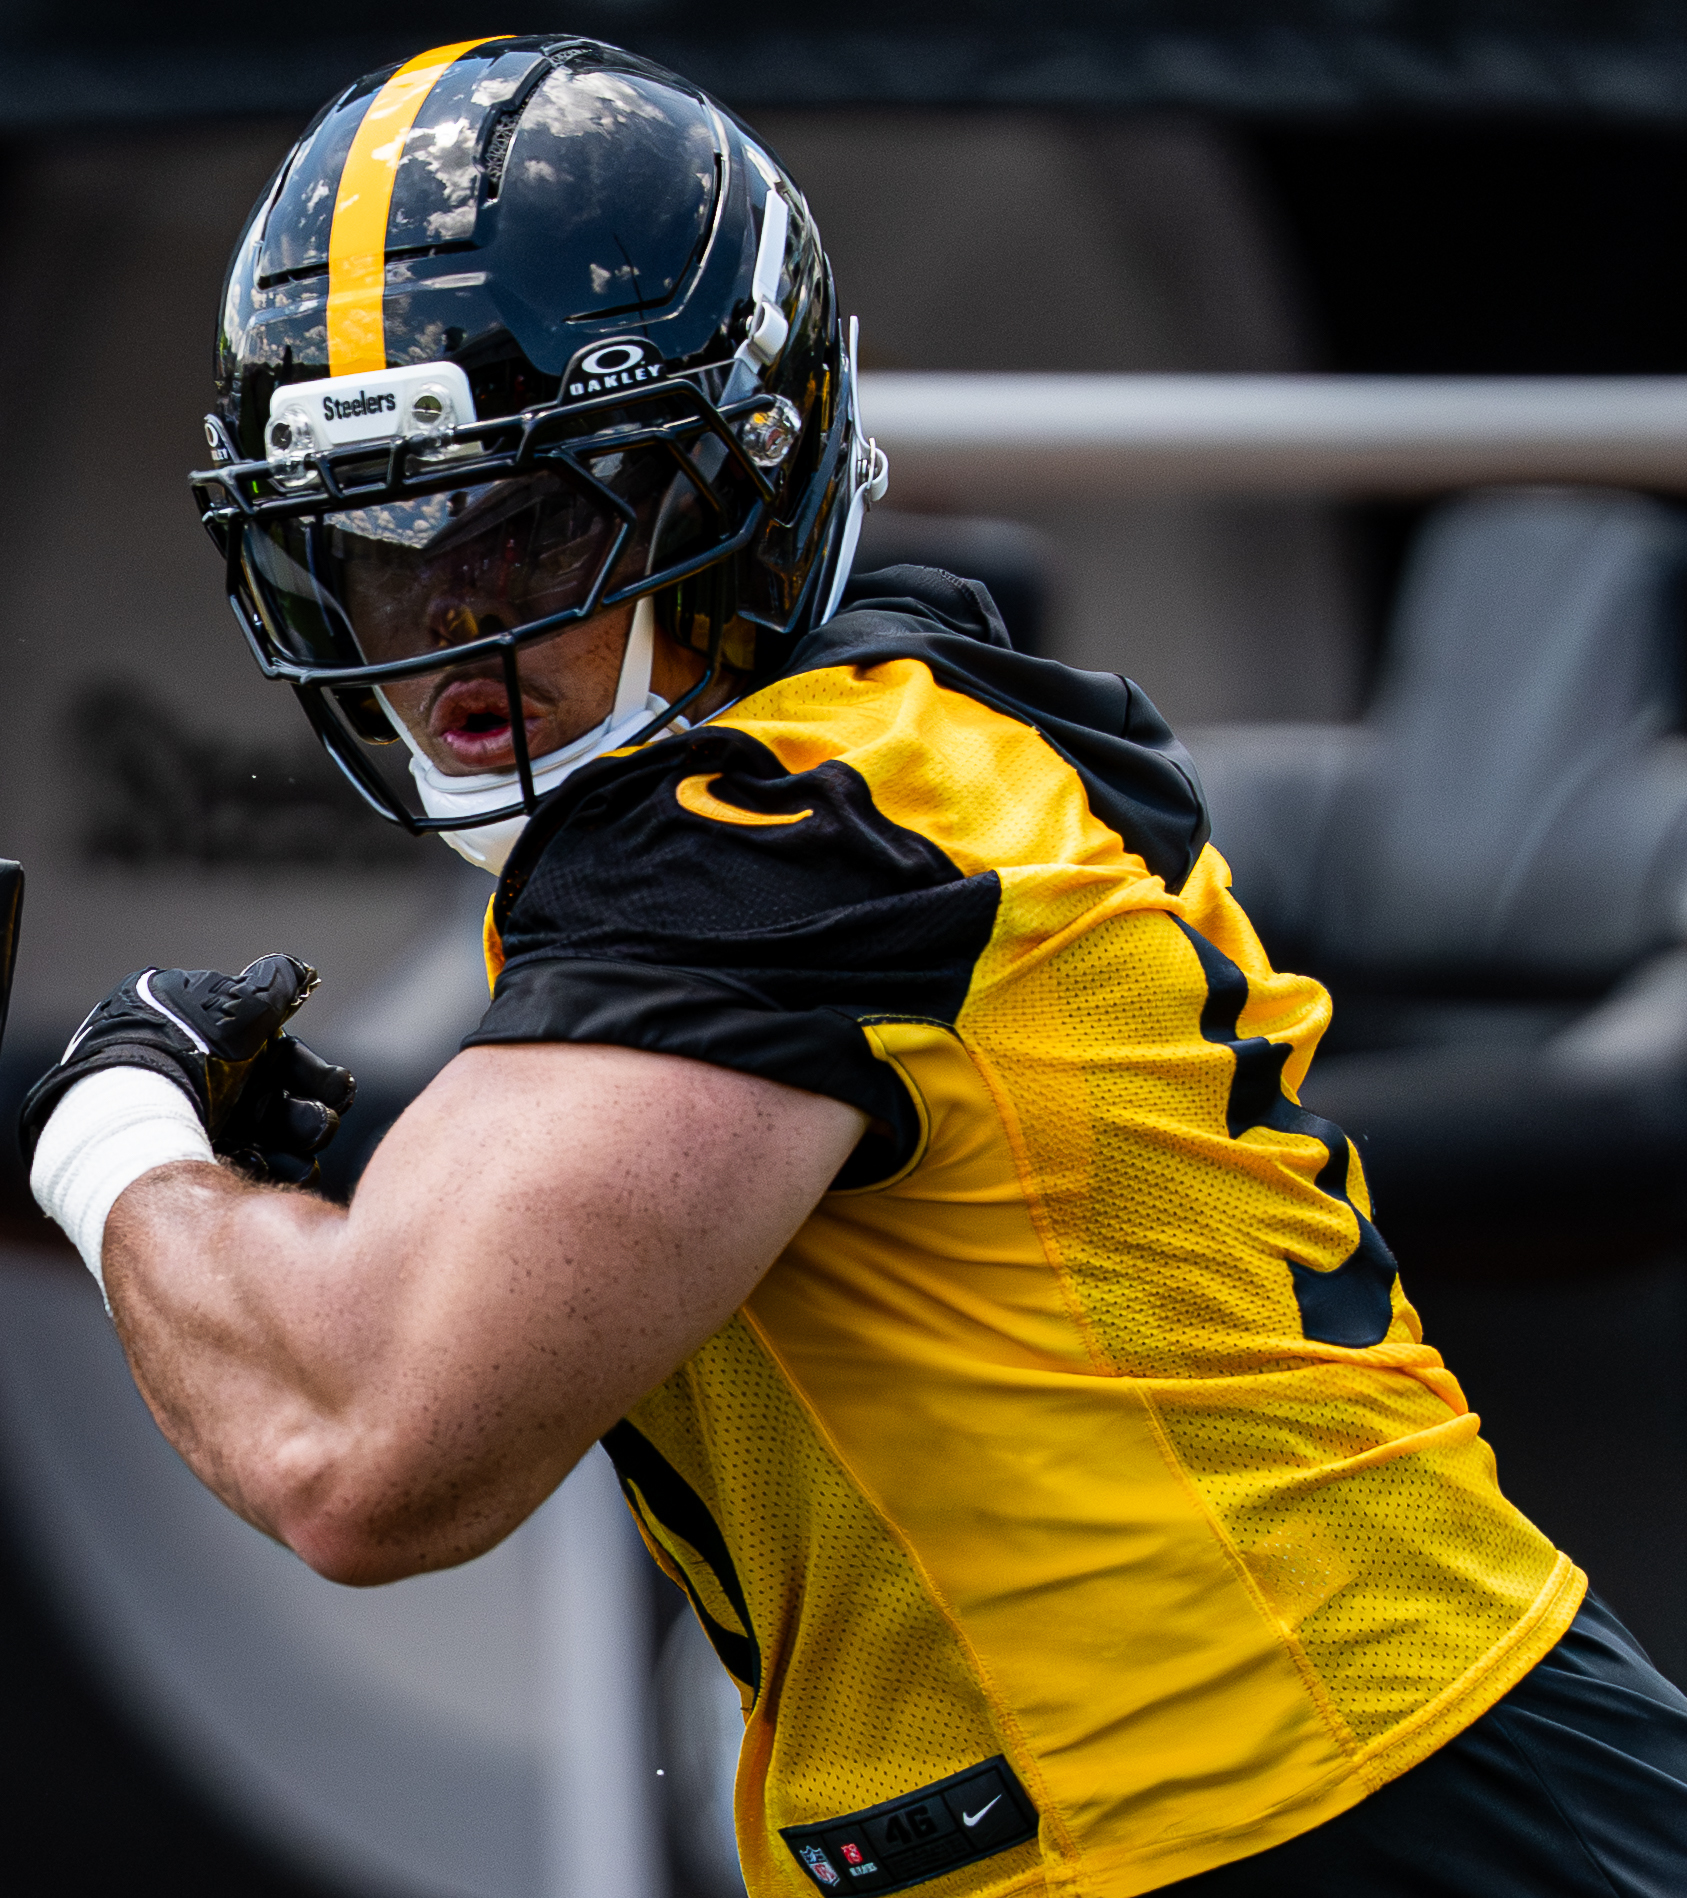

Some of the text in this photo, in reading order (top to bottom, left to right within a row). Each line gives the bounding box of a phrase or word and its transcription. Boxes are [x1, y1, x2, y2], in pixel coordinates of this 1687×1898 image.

[569, 364, 662, 396] OAKLEY
[323, 389, 396, 421] Steelers
[885, 1804, 938, 1845] 46
